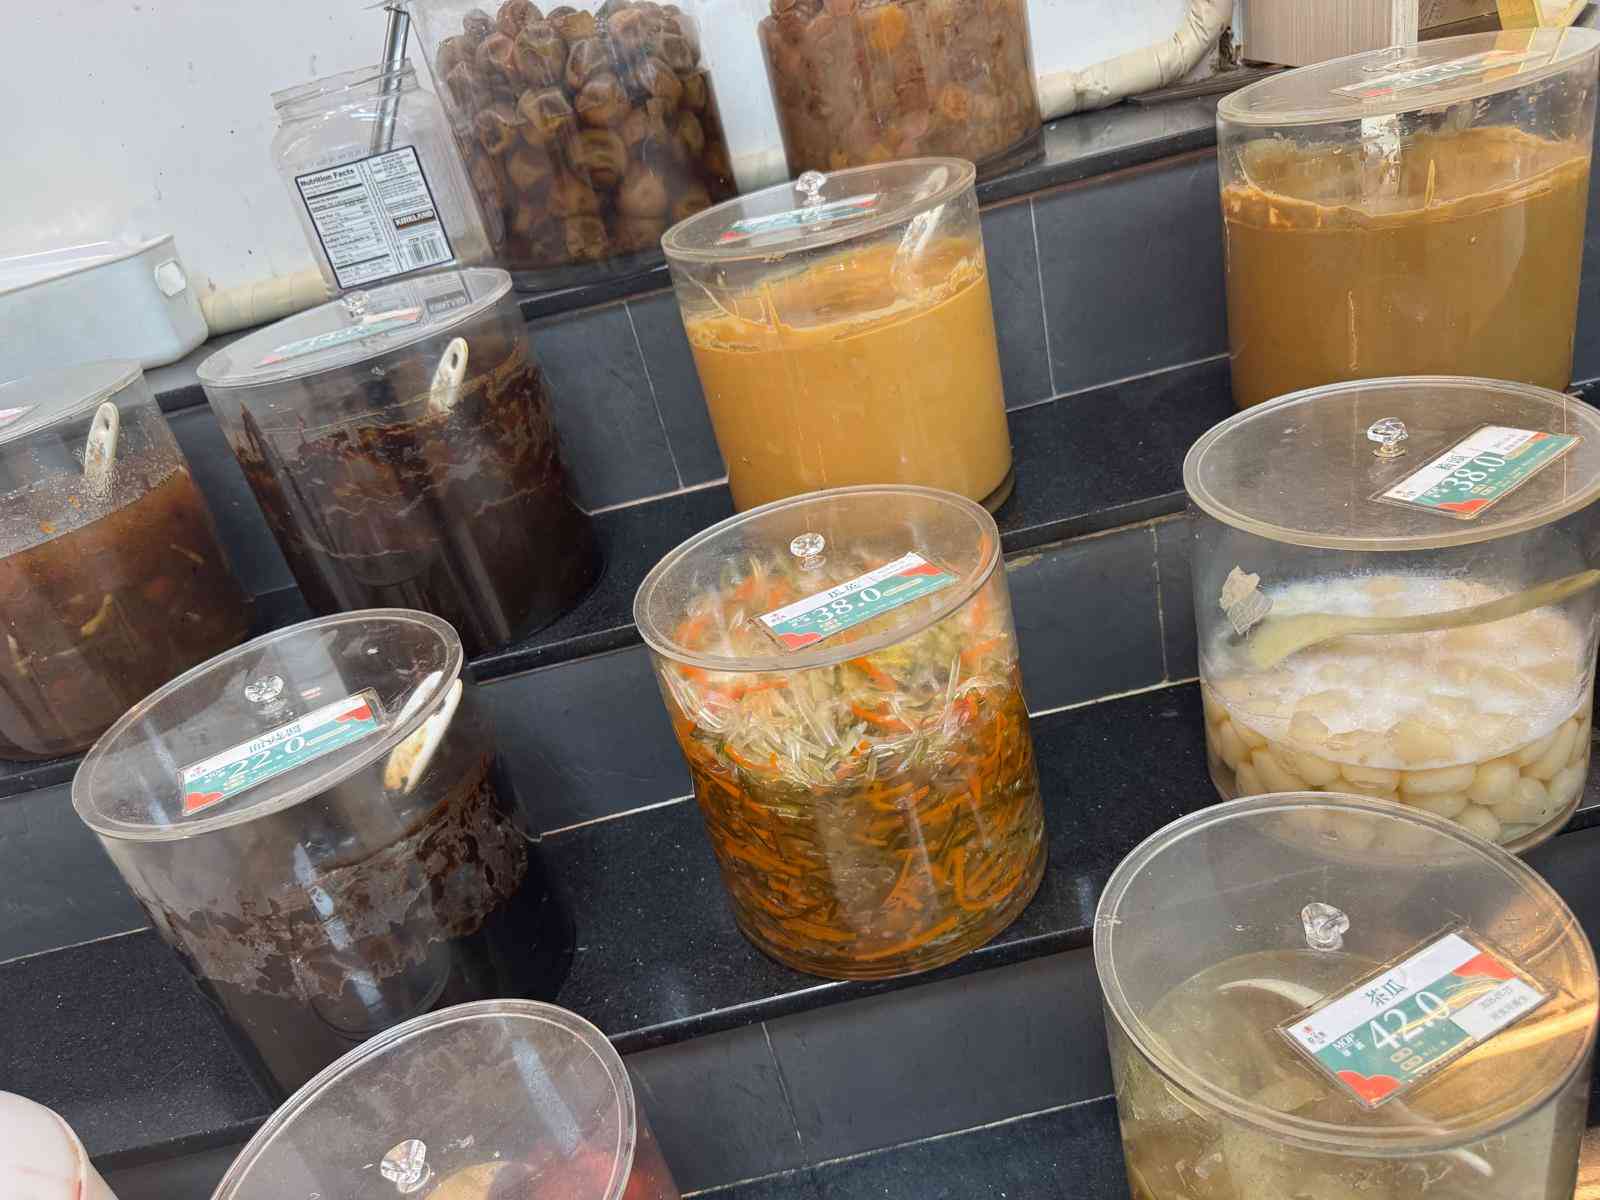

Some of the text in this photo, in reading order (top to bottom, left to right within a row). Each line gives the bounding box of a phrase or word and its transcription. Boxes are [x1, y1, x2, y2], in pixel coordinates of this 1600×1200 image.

[300, 175, 333, 187] Nutrition
[332, 169, 355, 179] Facts
[1442, 455, 1506, 491] 38.0
[816, 587, 881, 623] 38.0
[230, 736, 305, 779] 22.0
[1365, 979, 1408, 1007] 茶瓜
[1369, 991, 1450, 1049] 42.0
[1331, 1032, 1355, 1050] MOP
